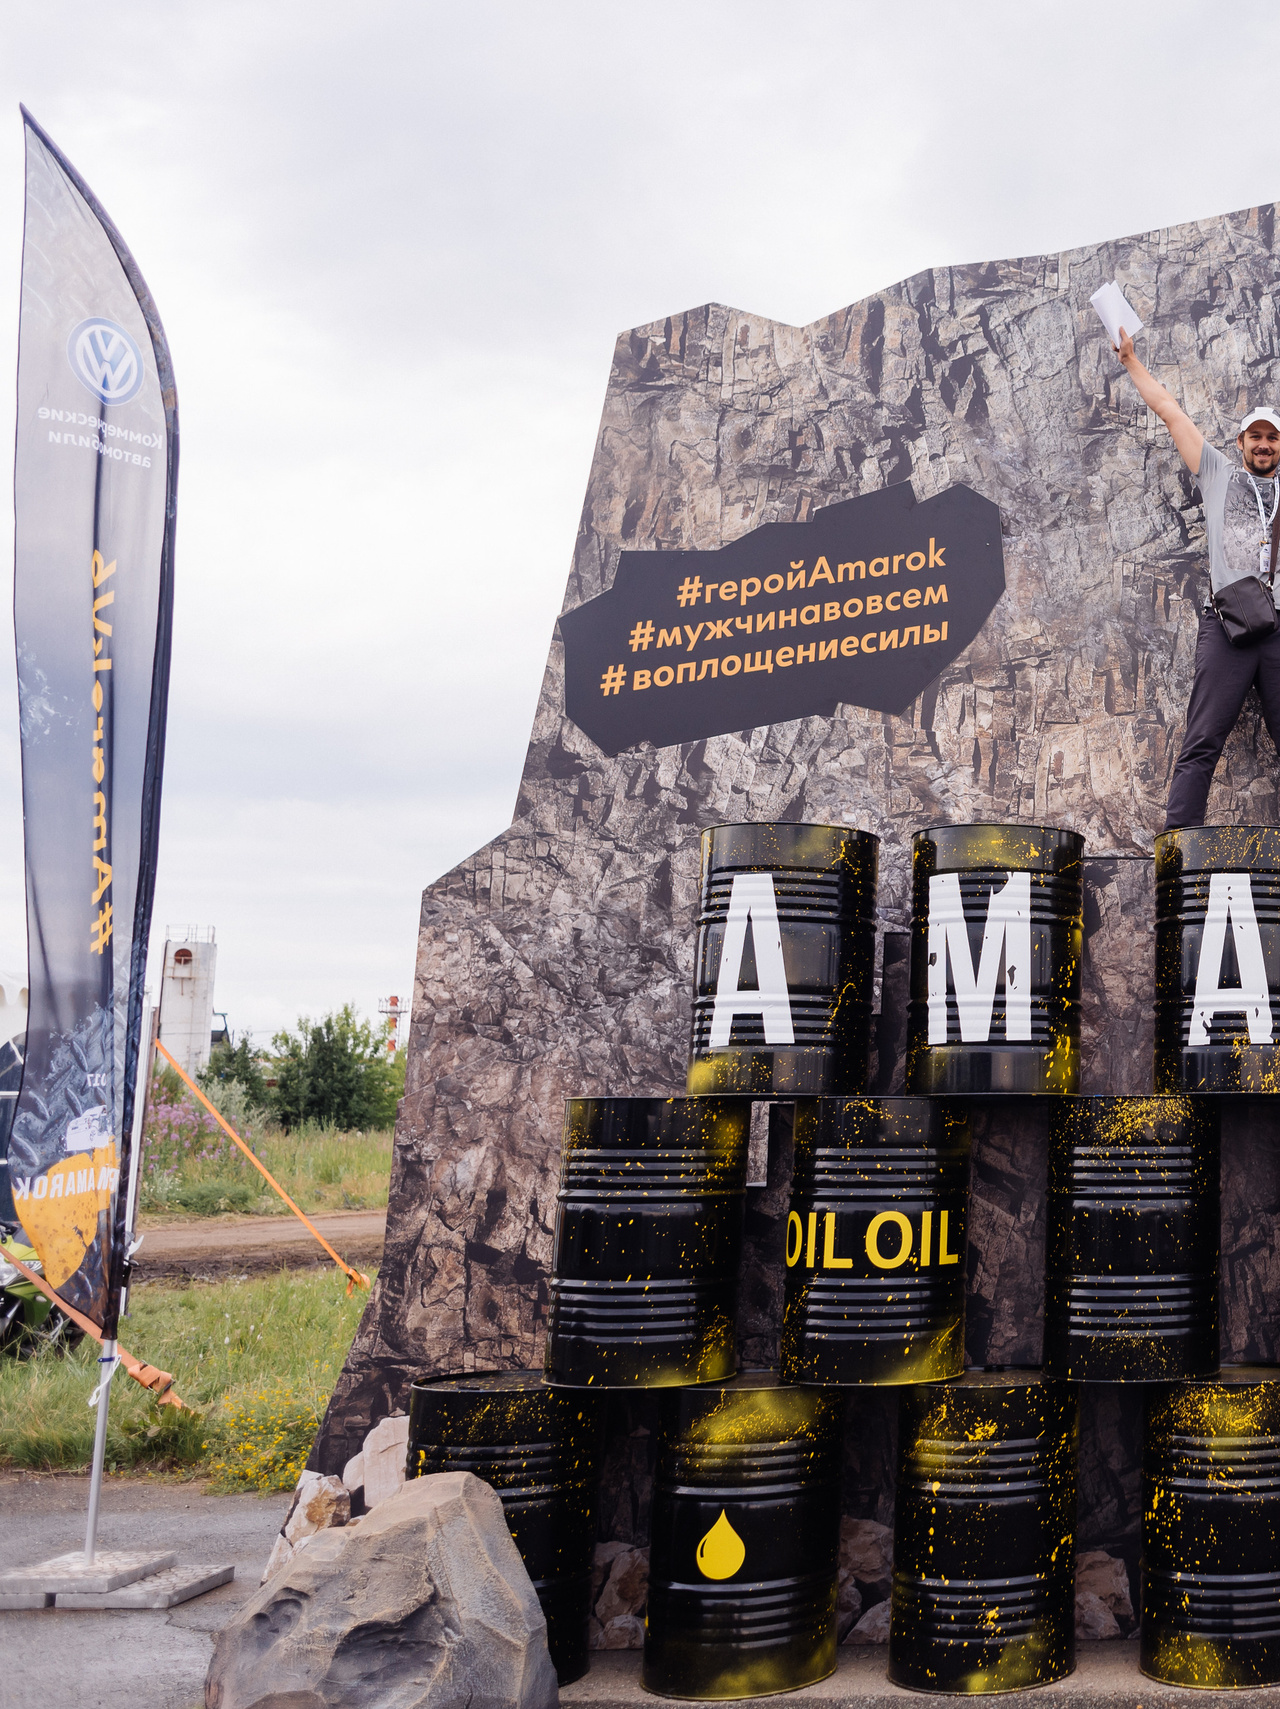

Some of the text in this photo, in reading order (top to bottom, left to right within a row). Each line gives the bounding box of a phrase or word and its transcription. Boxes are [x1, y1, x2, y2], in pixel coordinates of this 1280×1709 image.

[676, 537, 947, 608] #геройAmarok
[628, 584, 949, 653] #мужчинавовсем
[785, 1210, 959, 1269] OIL OIL
